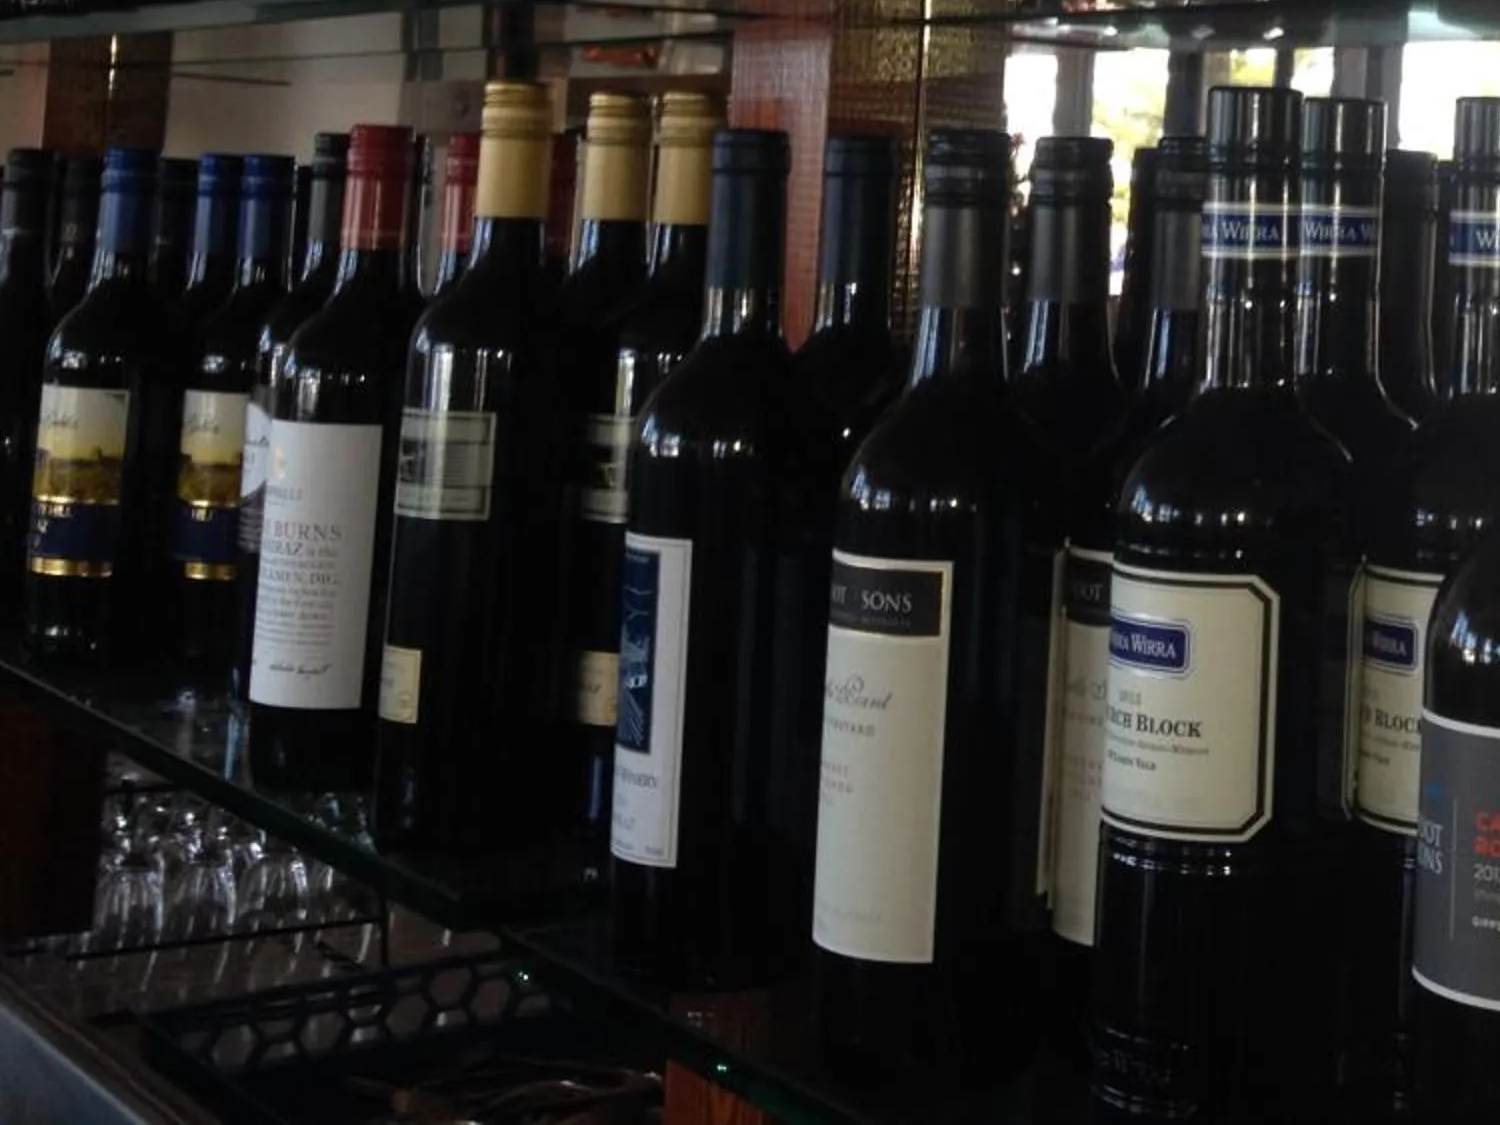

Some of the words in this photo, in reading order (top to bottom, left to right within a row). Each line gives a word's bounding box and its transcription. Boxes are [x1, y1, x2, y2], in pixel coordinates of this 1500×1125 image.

[861, 589, 913, 613] SONS
[1131, 633, 1177, 660] WIRRA
[1136, 712, 1203, 739] BLOCK
